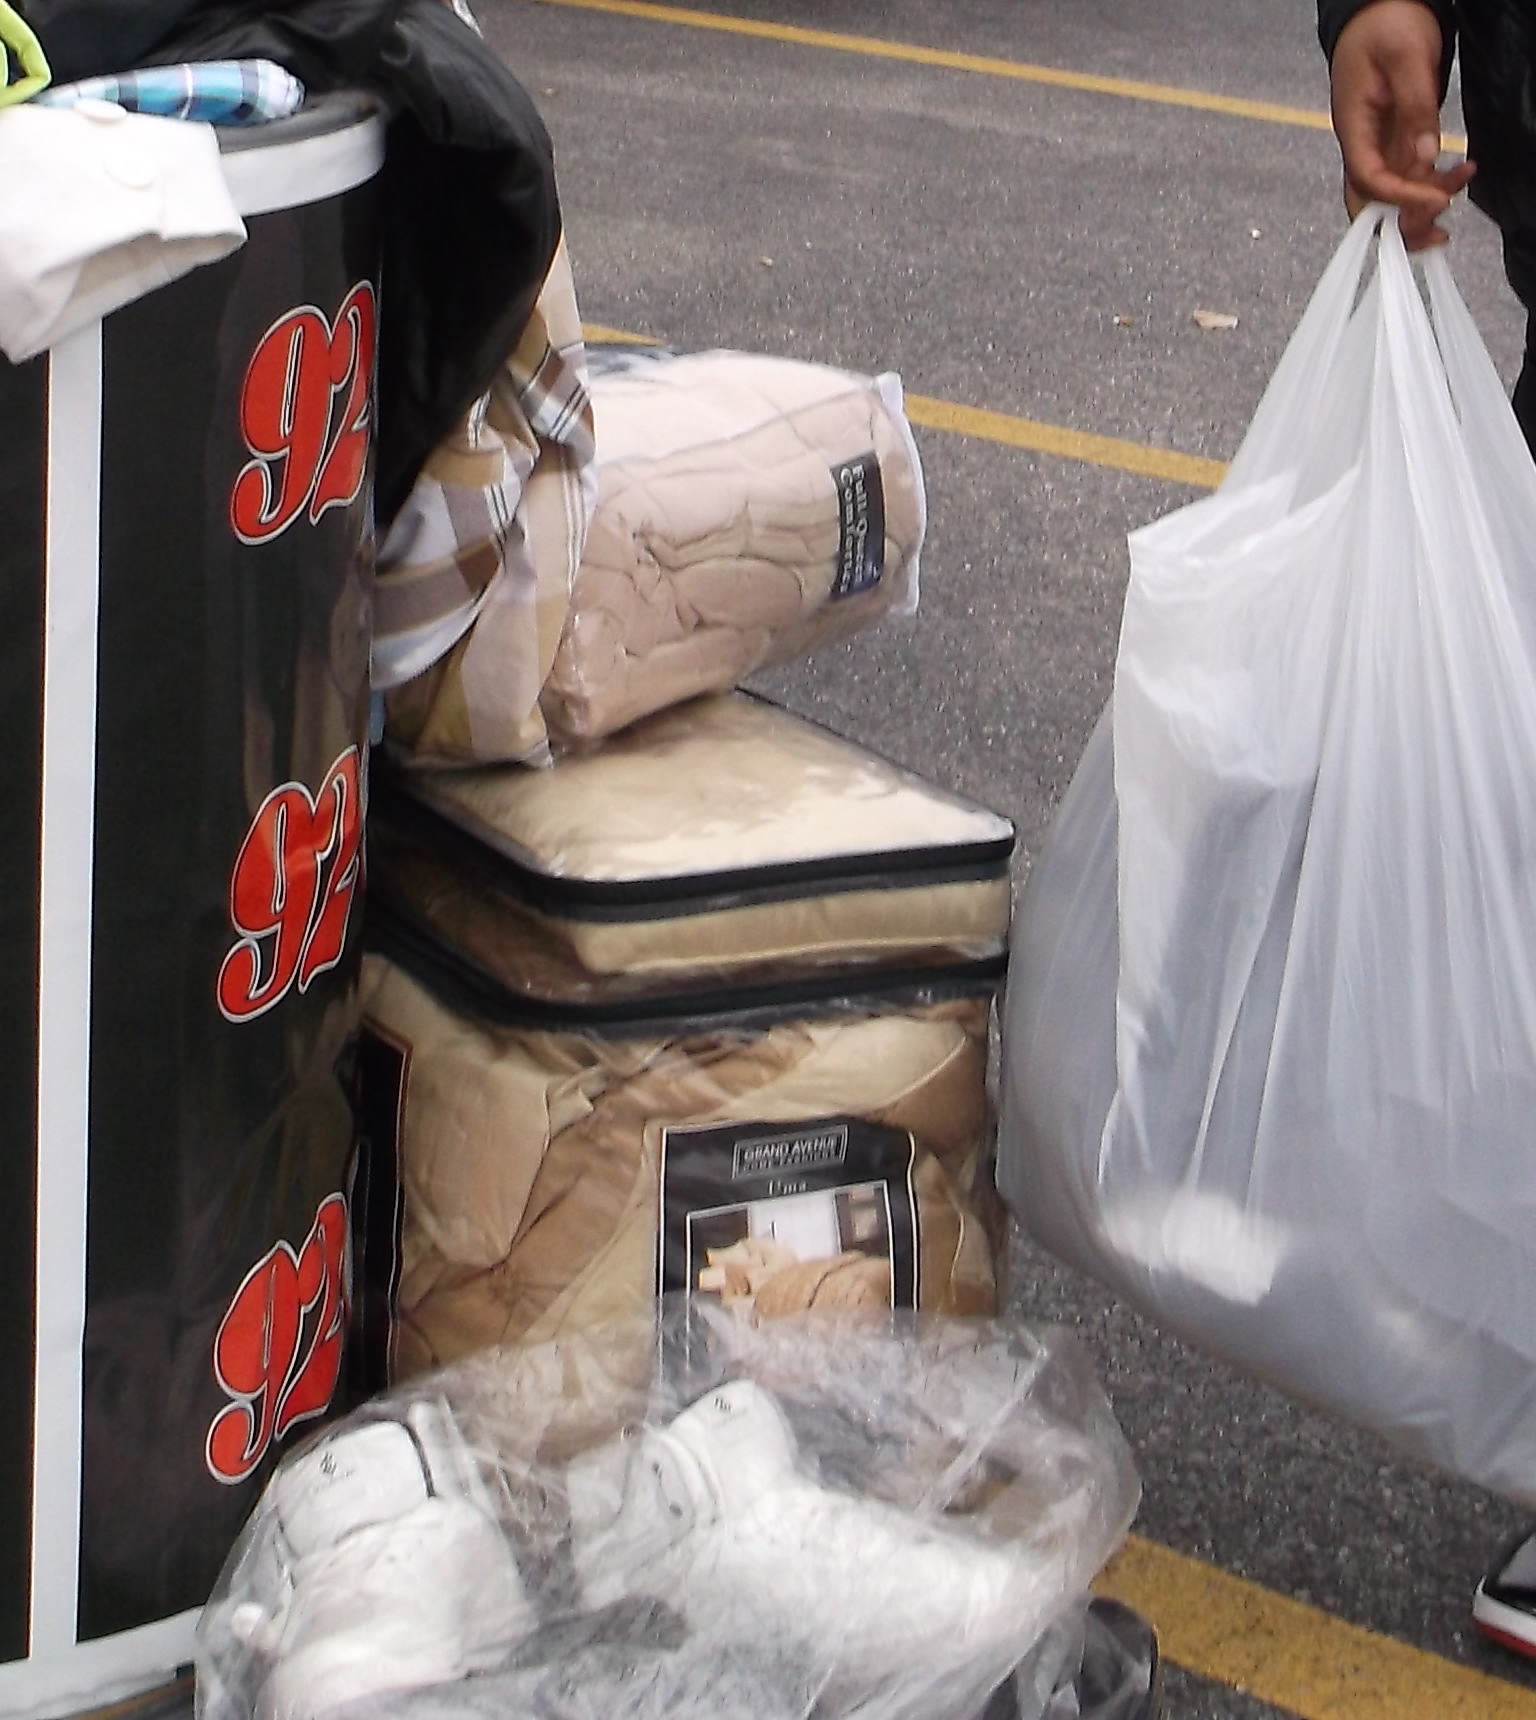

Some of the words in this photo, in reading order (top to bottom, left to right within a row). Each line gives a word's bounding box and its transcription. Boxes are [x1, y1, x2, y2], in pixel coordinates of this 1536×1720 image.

[231, 280, 376, 546] 92
[217, 744, 361, 1024] 92
[205, 1190, 349, 1486] 92
